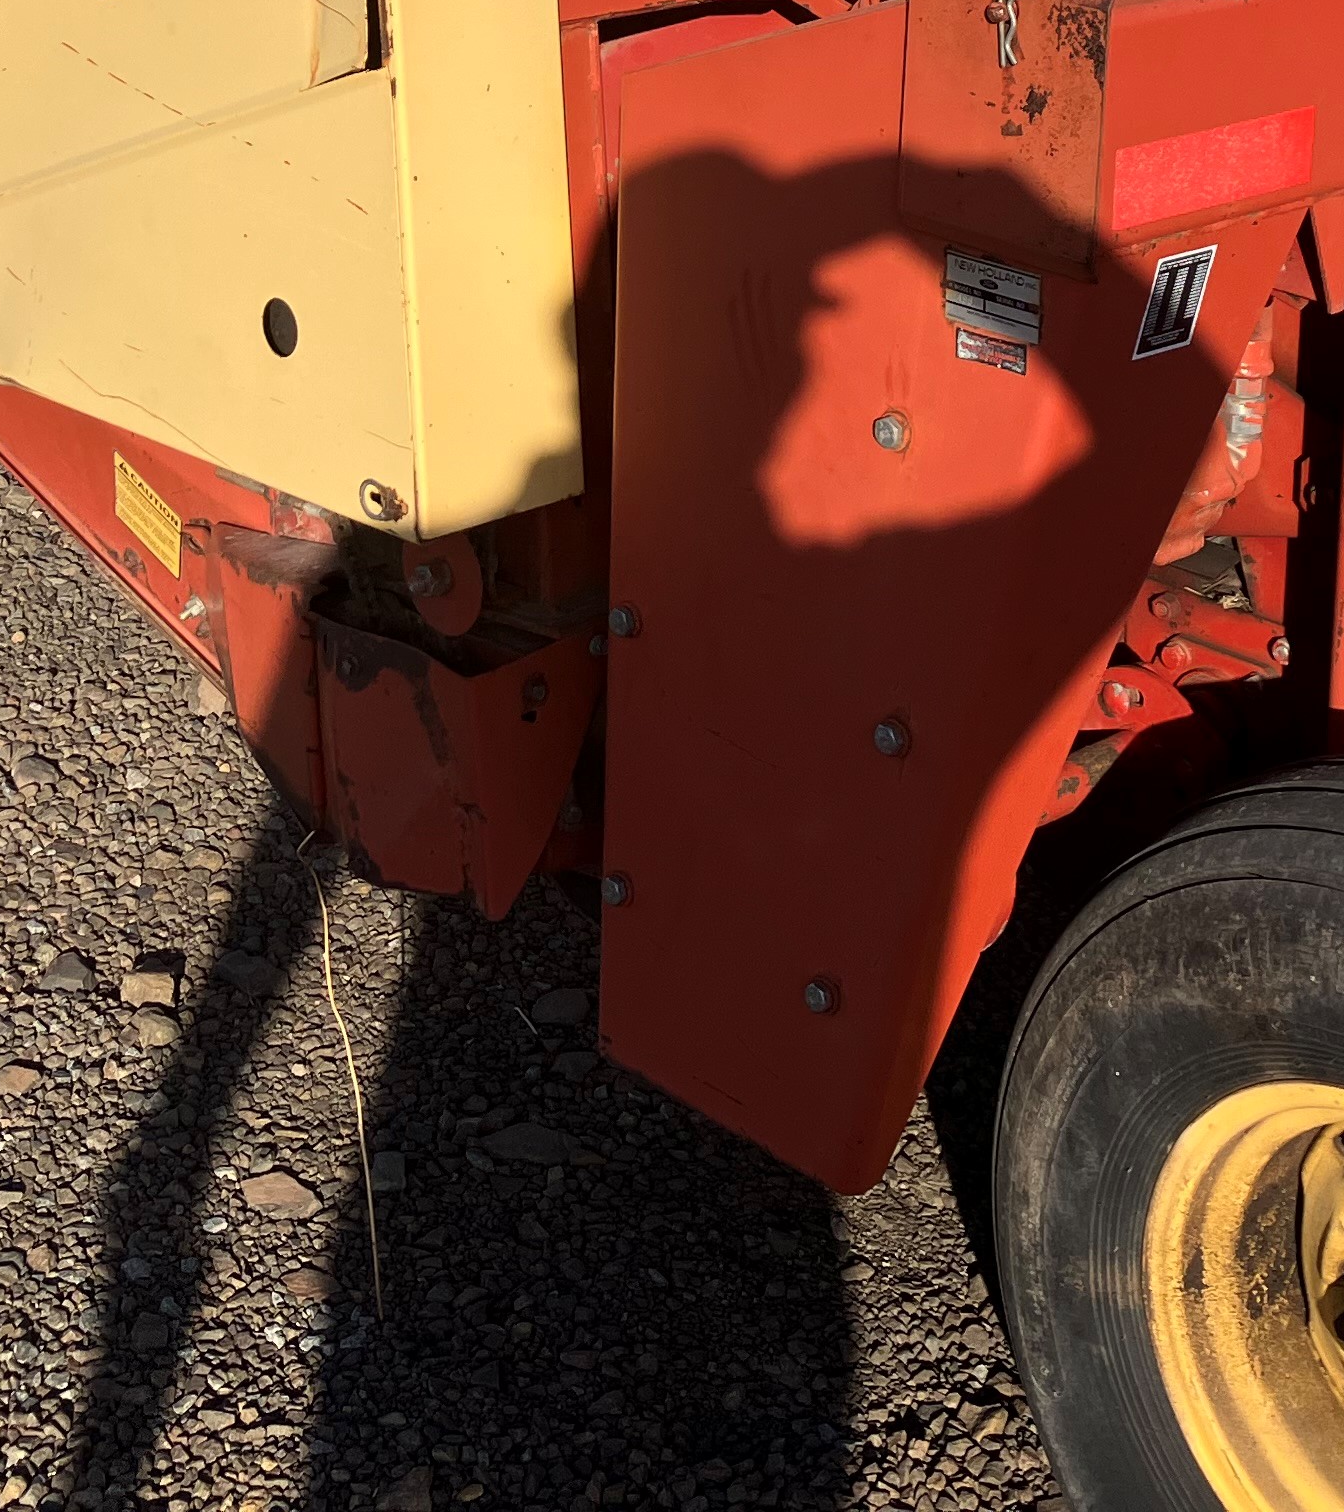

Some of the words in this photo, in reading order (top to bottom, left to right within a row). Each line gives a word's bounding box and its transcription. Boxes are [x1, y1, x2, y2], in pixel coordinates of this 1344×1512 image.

[954, 257, 976, 274] NEW
[977, 265, 1025, 287] HOLLAND
[129, 473, 179, 527] CAUTION
